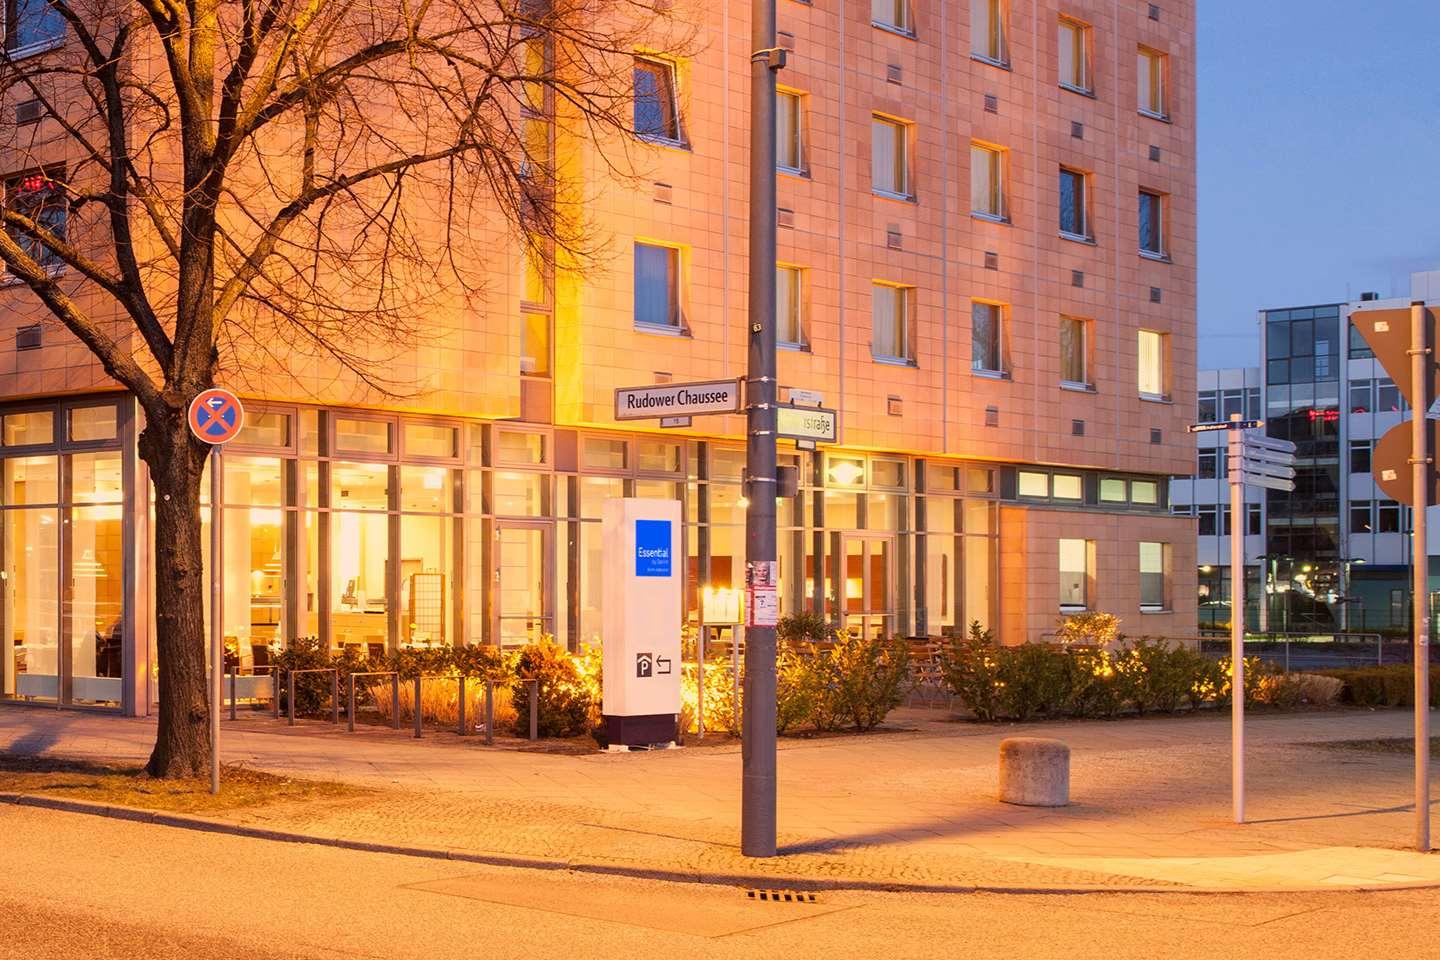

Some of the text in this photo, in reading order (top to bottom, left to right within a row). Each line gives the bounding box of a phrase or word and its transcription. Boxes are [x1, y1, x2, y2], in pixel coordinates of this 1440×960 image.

[627, 390, 728, 409] Rudower Chaussee
[638, 546, 669, 558] Essential
